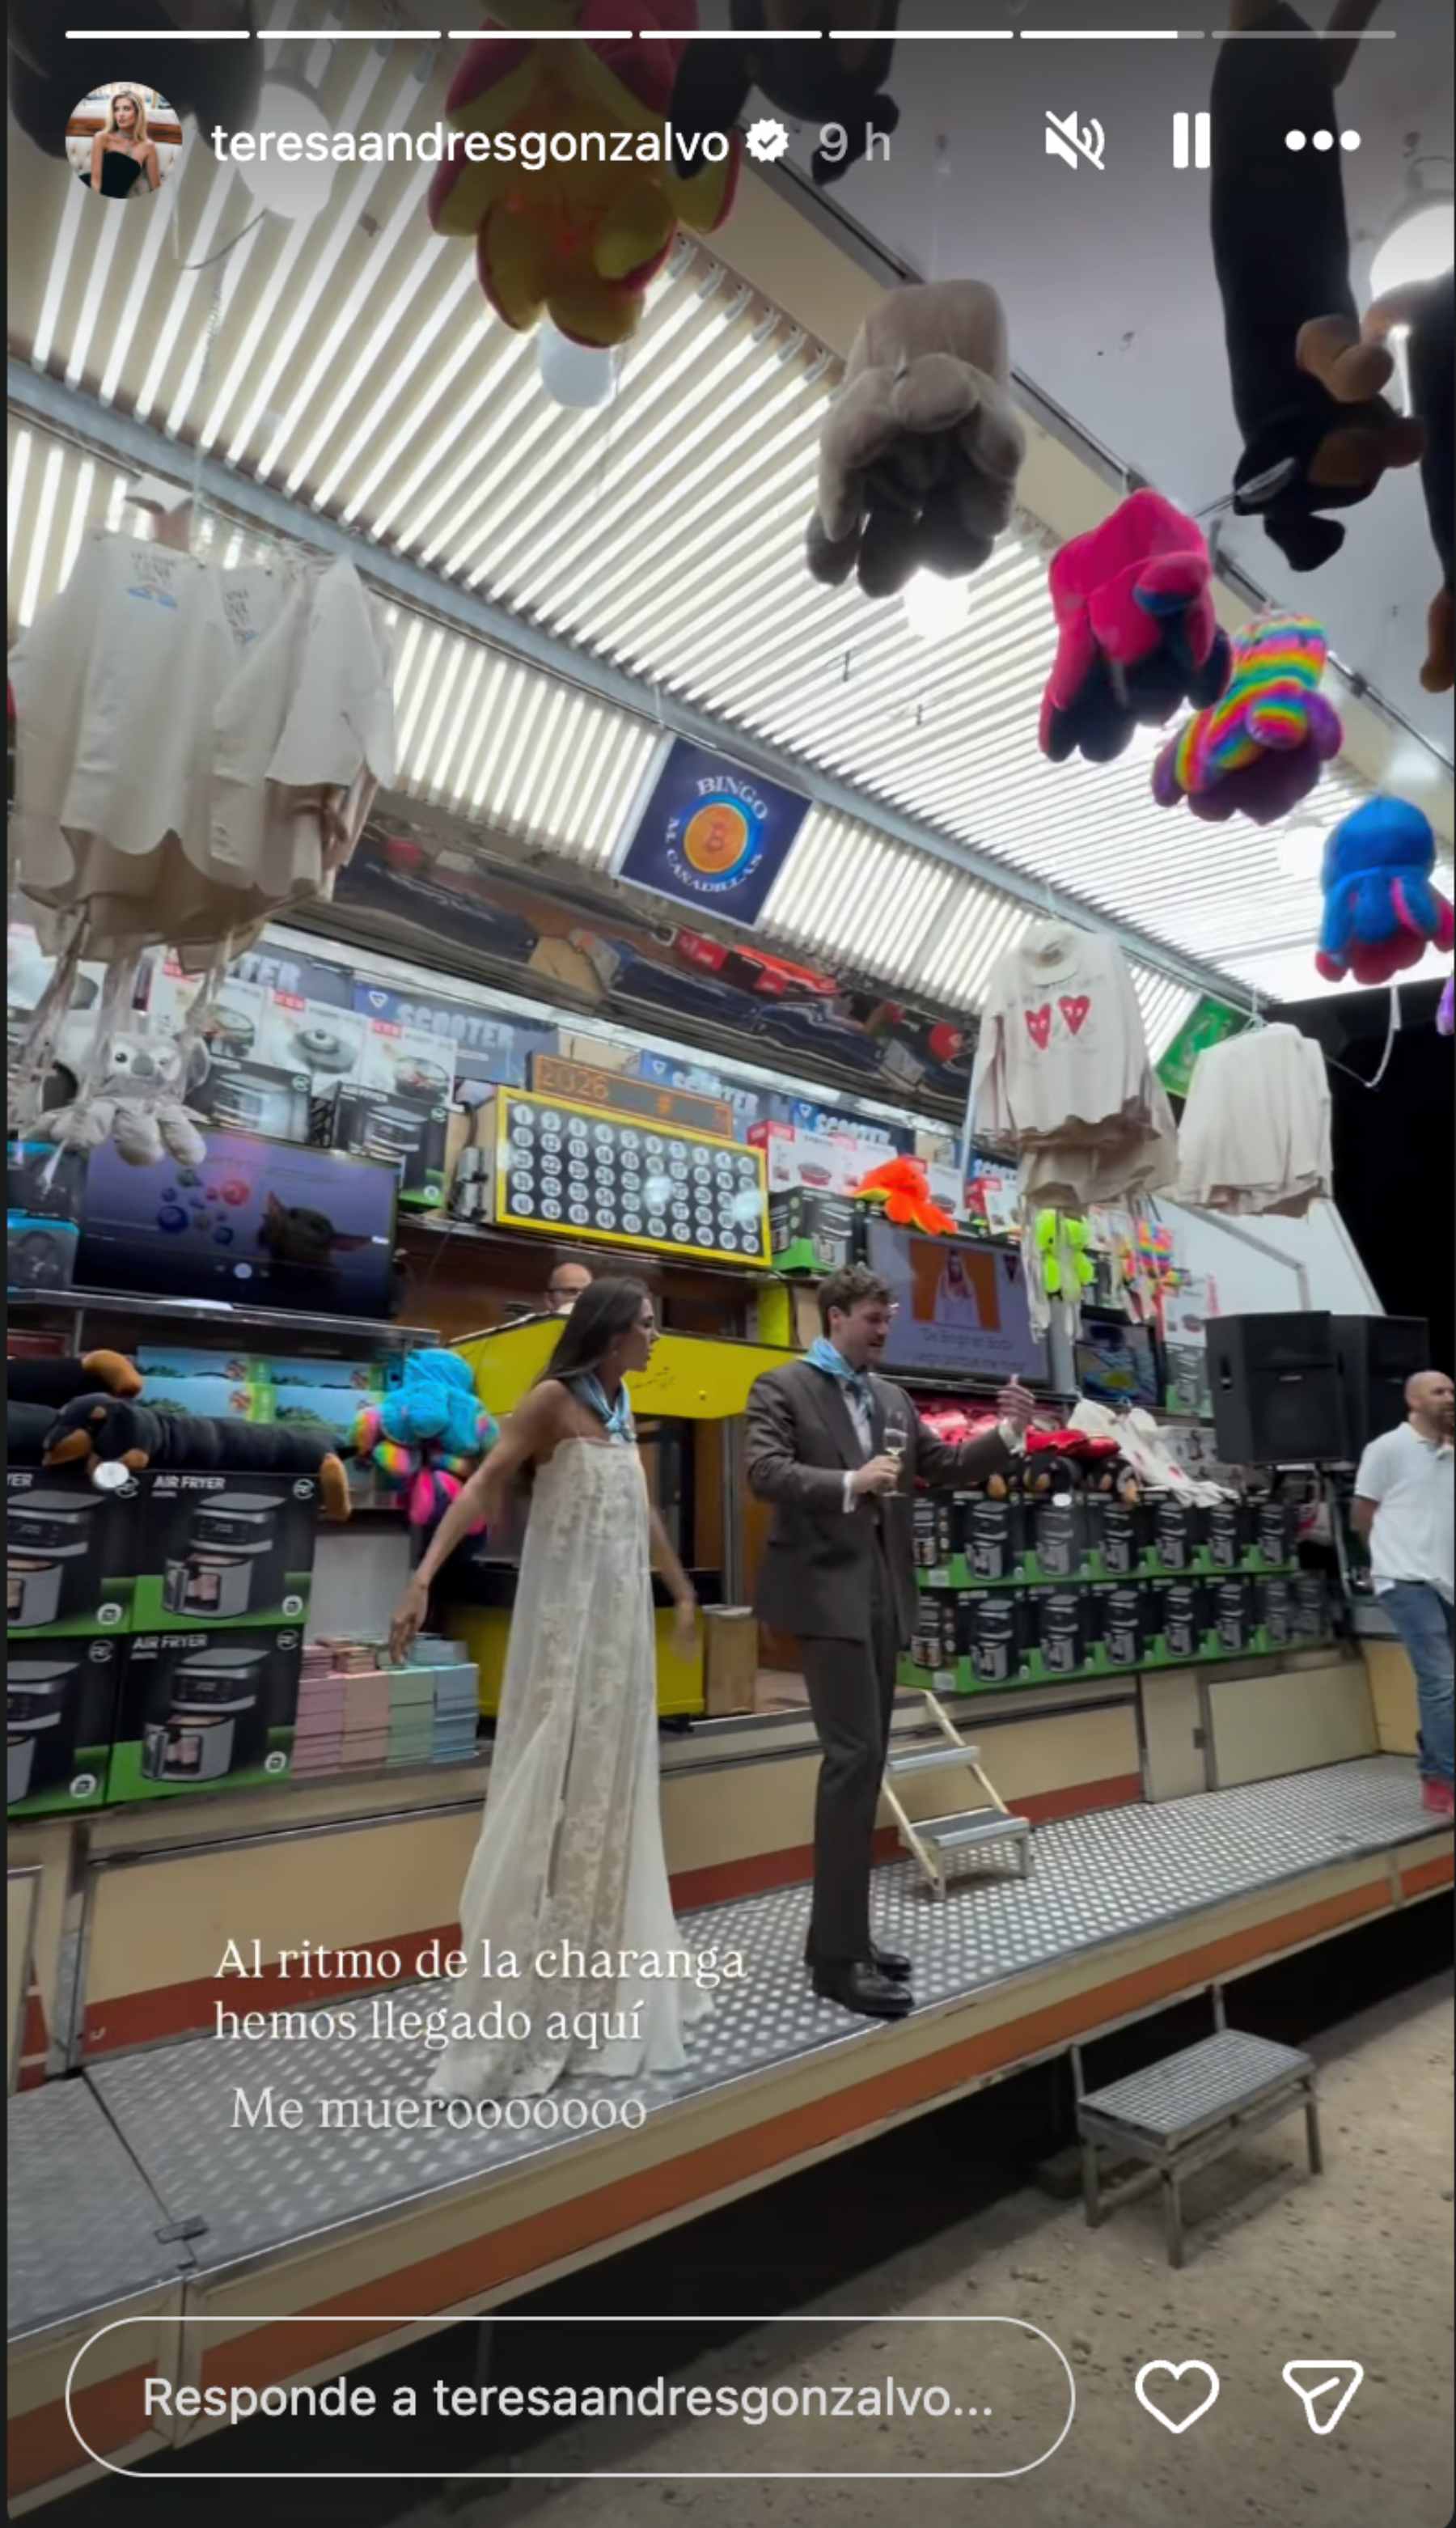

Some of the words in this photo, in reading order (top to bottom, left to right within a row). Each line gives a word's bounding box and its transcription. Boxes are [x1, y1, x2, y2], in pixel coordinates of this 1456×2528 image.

[696, 776, 769, 820] BINGO
[396, 1003, 515, 1048] SCOOTER
[152, 1475, 180, 1488] AIR
[180, 1476, 226, 1489] FRYER
[133, 1636, 159, 1649] AIR
[161, 1634, 208, 1649] FRYER
